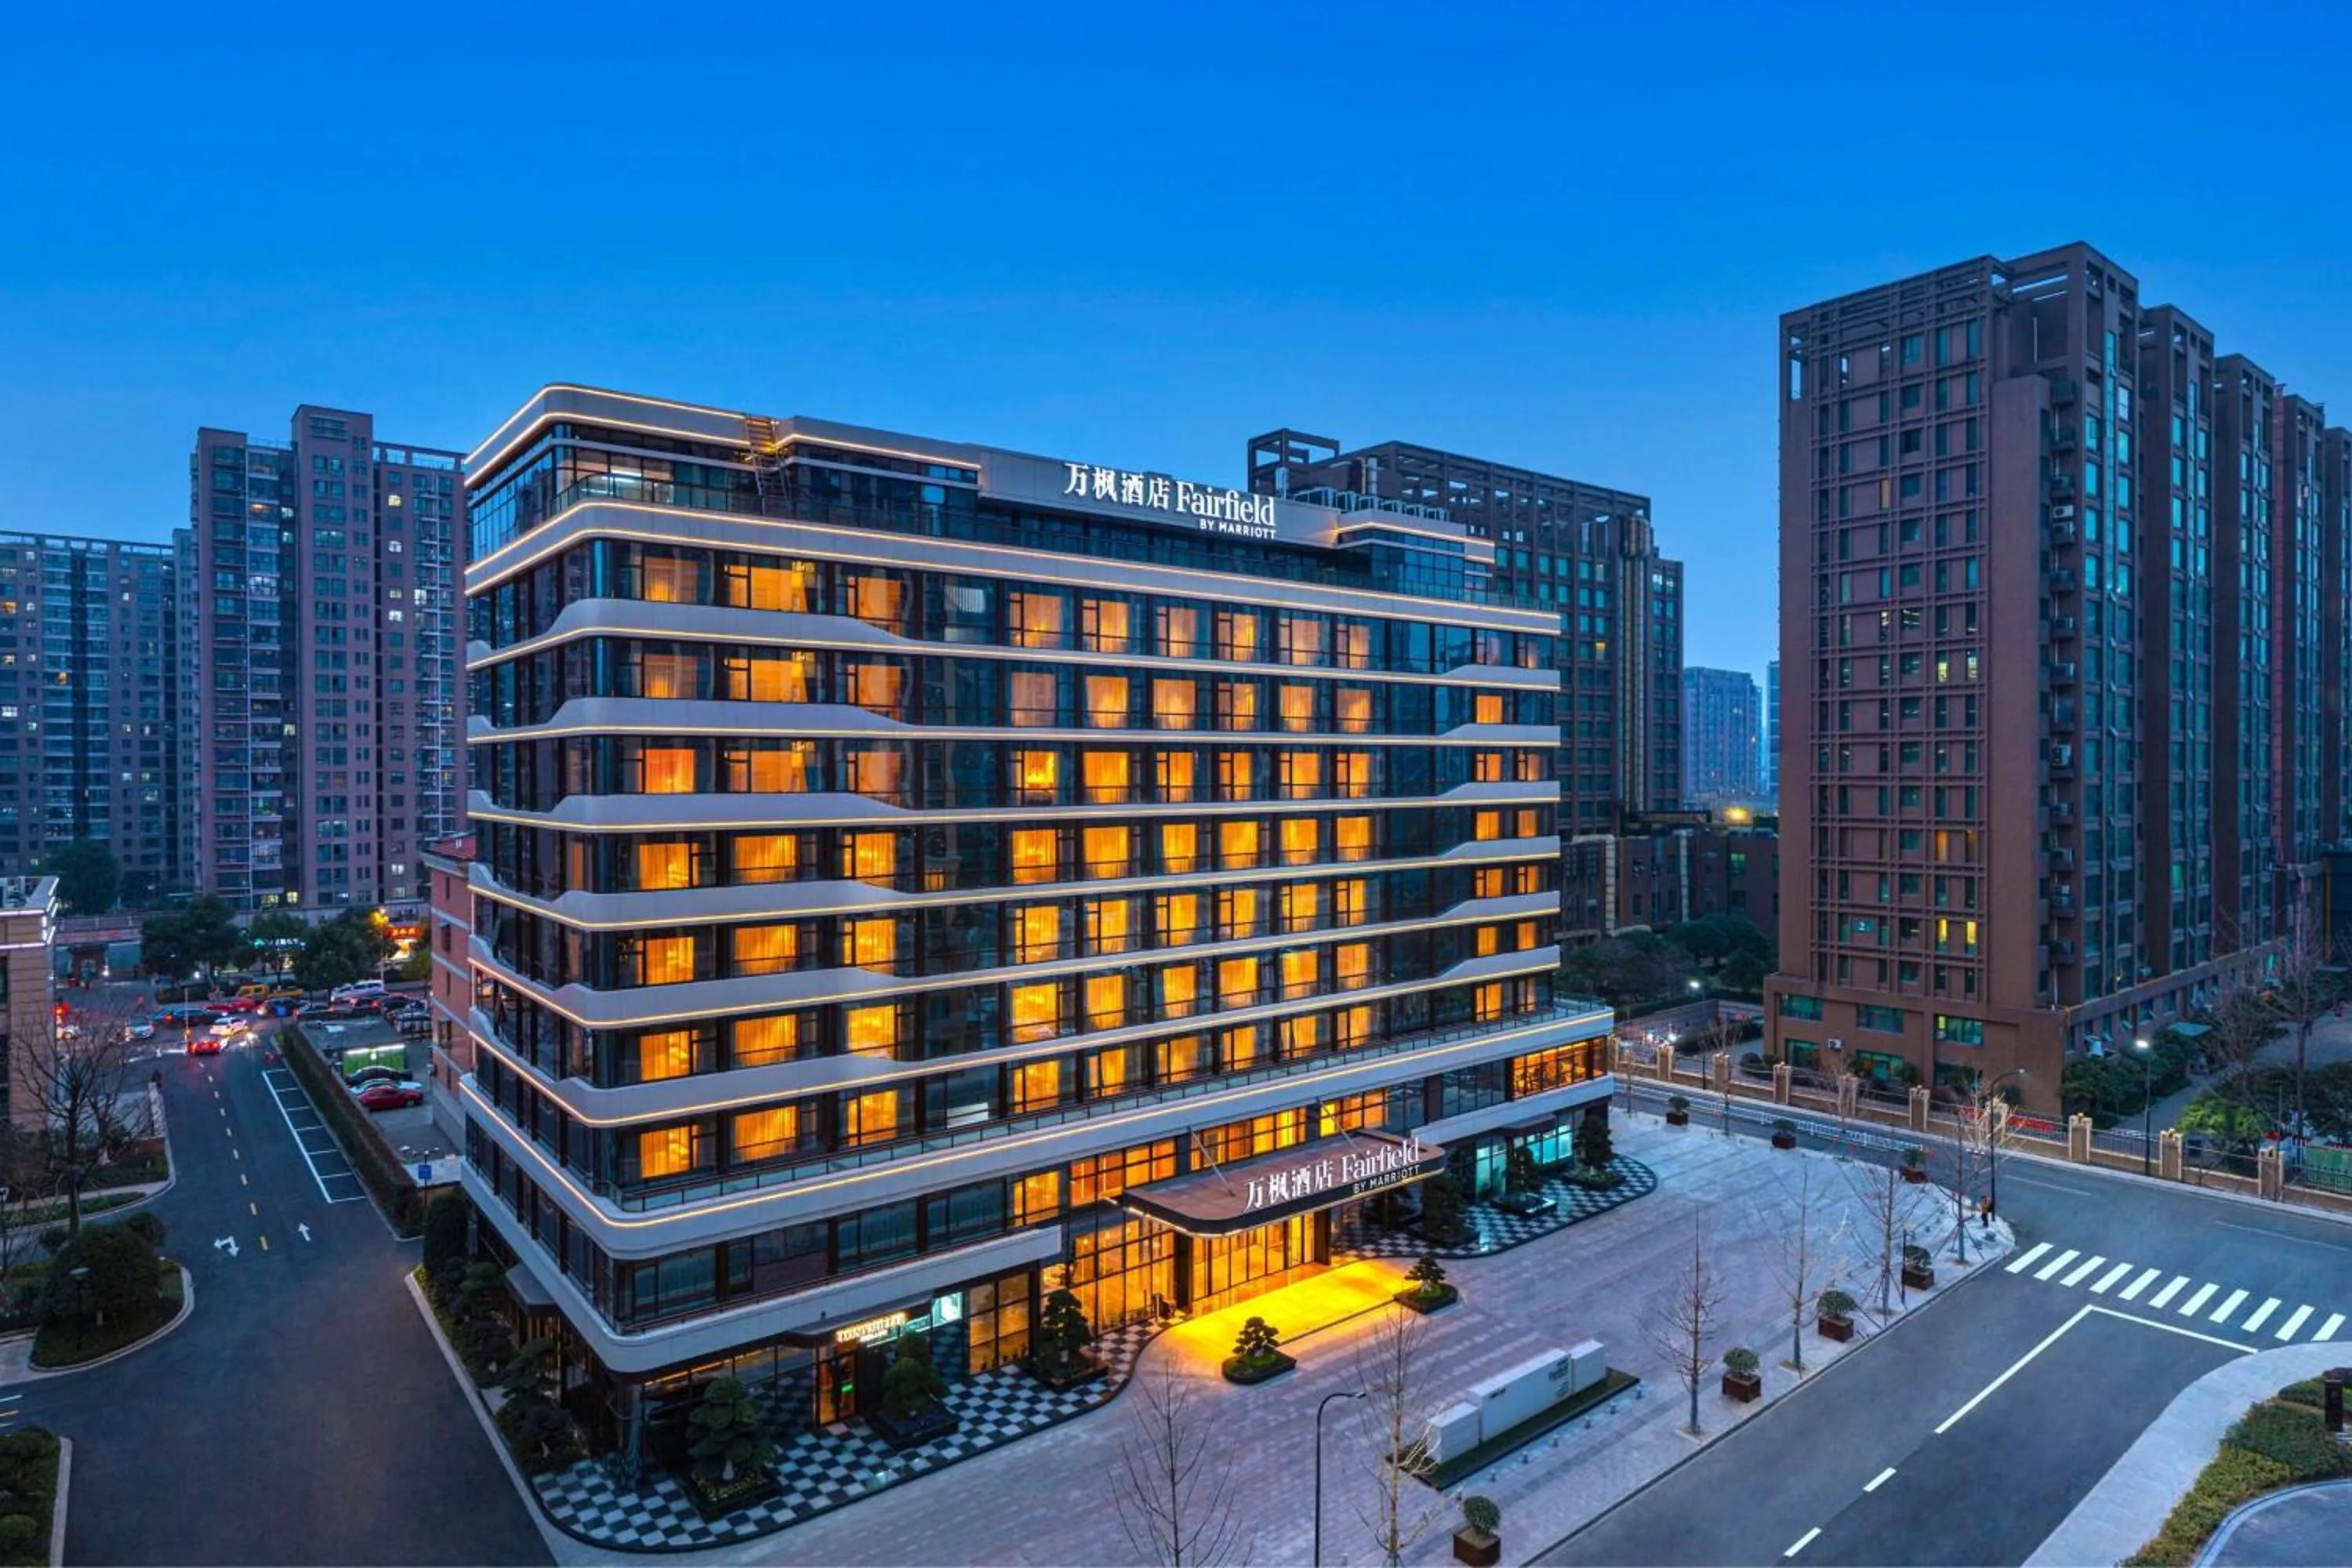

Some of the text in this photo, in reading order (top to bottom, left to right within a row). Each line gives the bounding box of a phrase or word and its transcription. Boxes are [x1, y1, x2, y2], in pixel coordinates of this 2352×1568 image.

[1064, 462, 1276, 526] 万枫酒店 Fairfield
[1200, 518, 1277, 540] BY MARRIOTT
[1243, 1137, 1419, 1213] 万枫酒店 Fairfield
[1352, 1164, 1421, 1194] BY MARRIOTT
